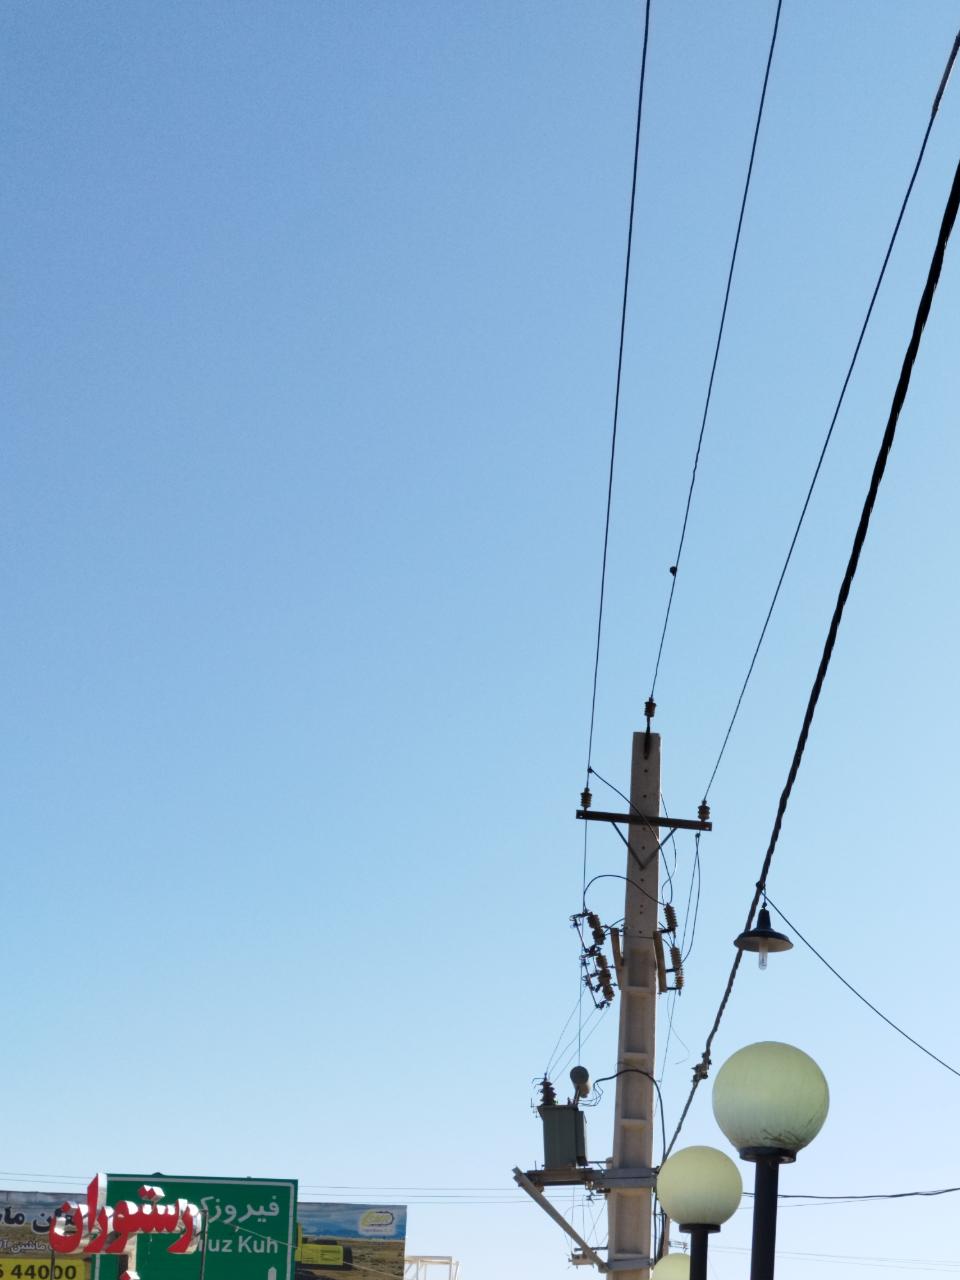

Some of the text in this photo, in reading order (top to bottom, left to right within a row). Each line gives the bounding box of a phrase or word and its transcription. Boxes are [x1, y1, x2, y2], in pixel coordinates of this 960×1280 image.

[49, 1173, 202, 1255] رستوران
[238, 1235, 279, 1254] Kuh
[11, 1263, 77, 1280] 44000
